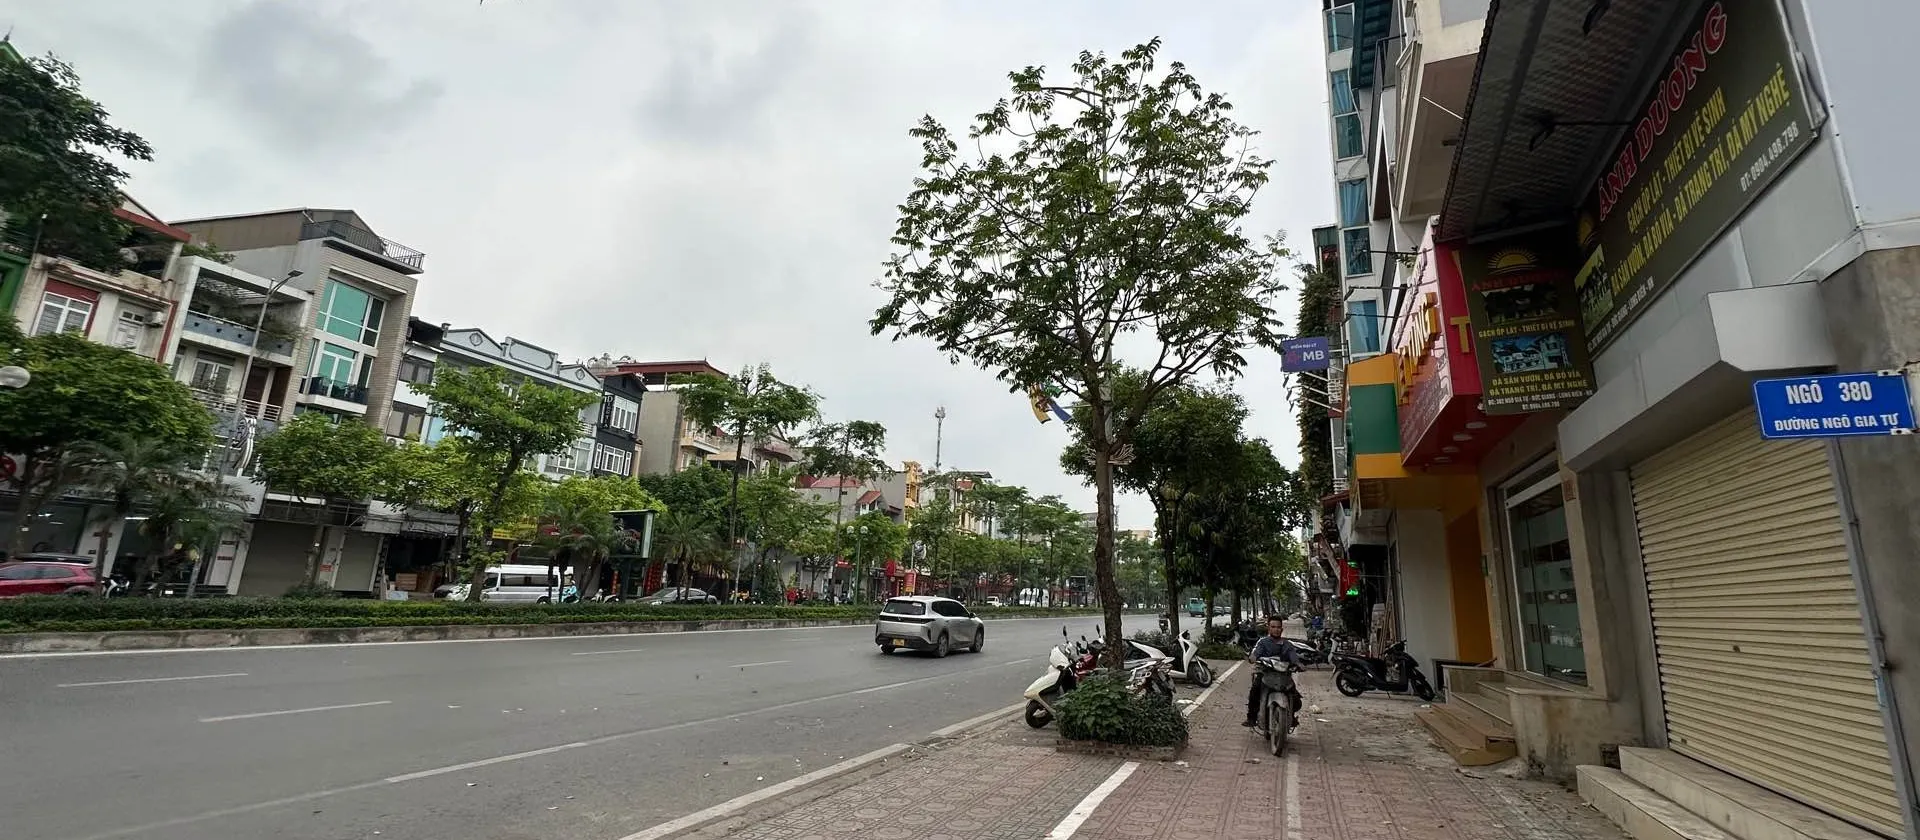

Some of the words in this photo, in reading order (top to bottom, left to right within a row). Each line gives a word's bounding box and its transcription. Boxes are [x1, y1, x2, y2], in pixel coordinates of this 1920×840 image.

[1635, 1, 1728, 162] DƯƠNG
[1702, 86, 1726, 135] SINH
[1685, 162, 1712, 209] TRANG
[1756, 62, 1790, 127] NGHỆ
[1303, 350, 1324, 362] MB
[1785, 380, 1823, 405] NGÕ
[1838, 381, 1872, 402] 380
[1774, 416, 1820, 431] ĐƯỜNG
[1823, 414, 1851, 429] NGÔ
[1855, 414, 1878, 428] GIA
[1880, 412, 1899, 429] TỰ
